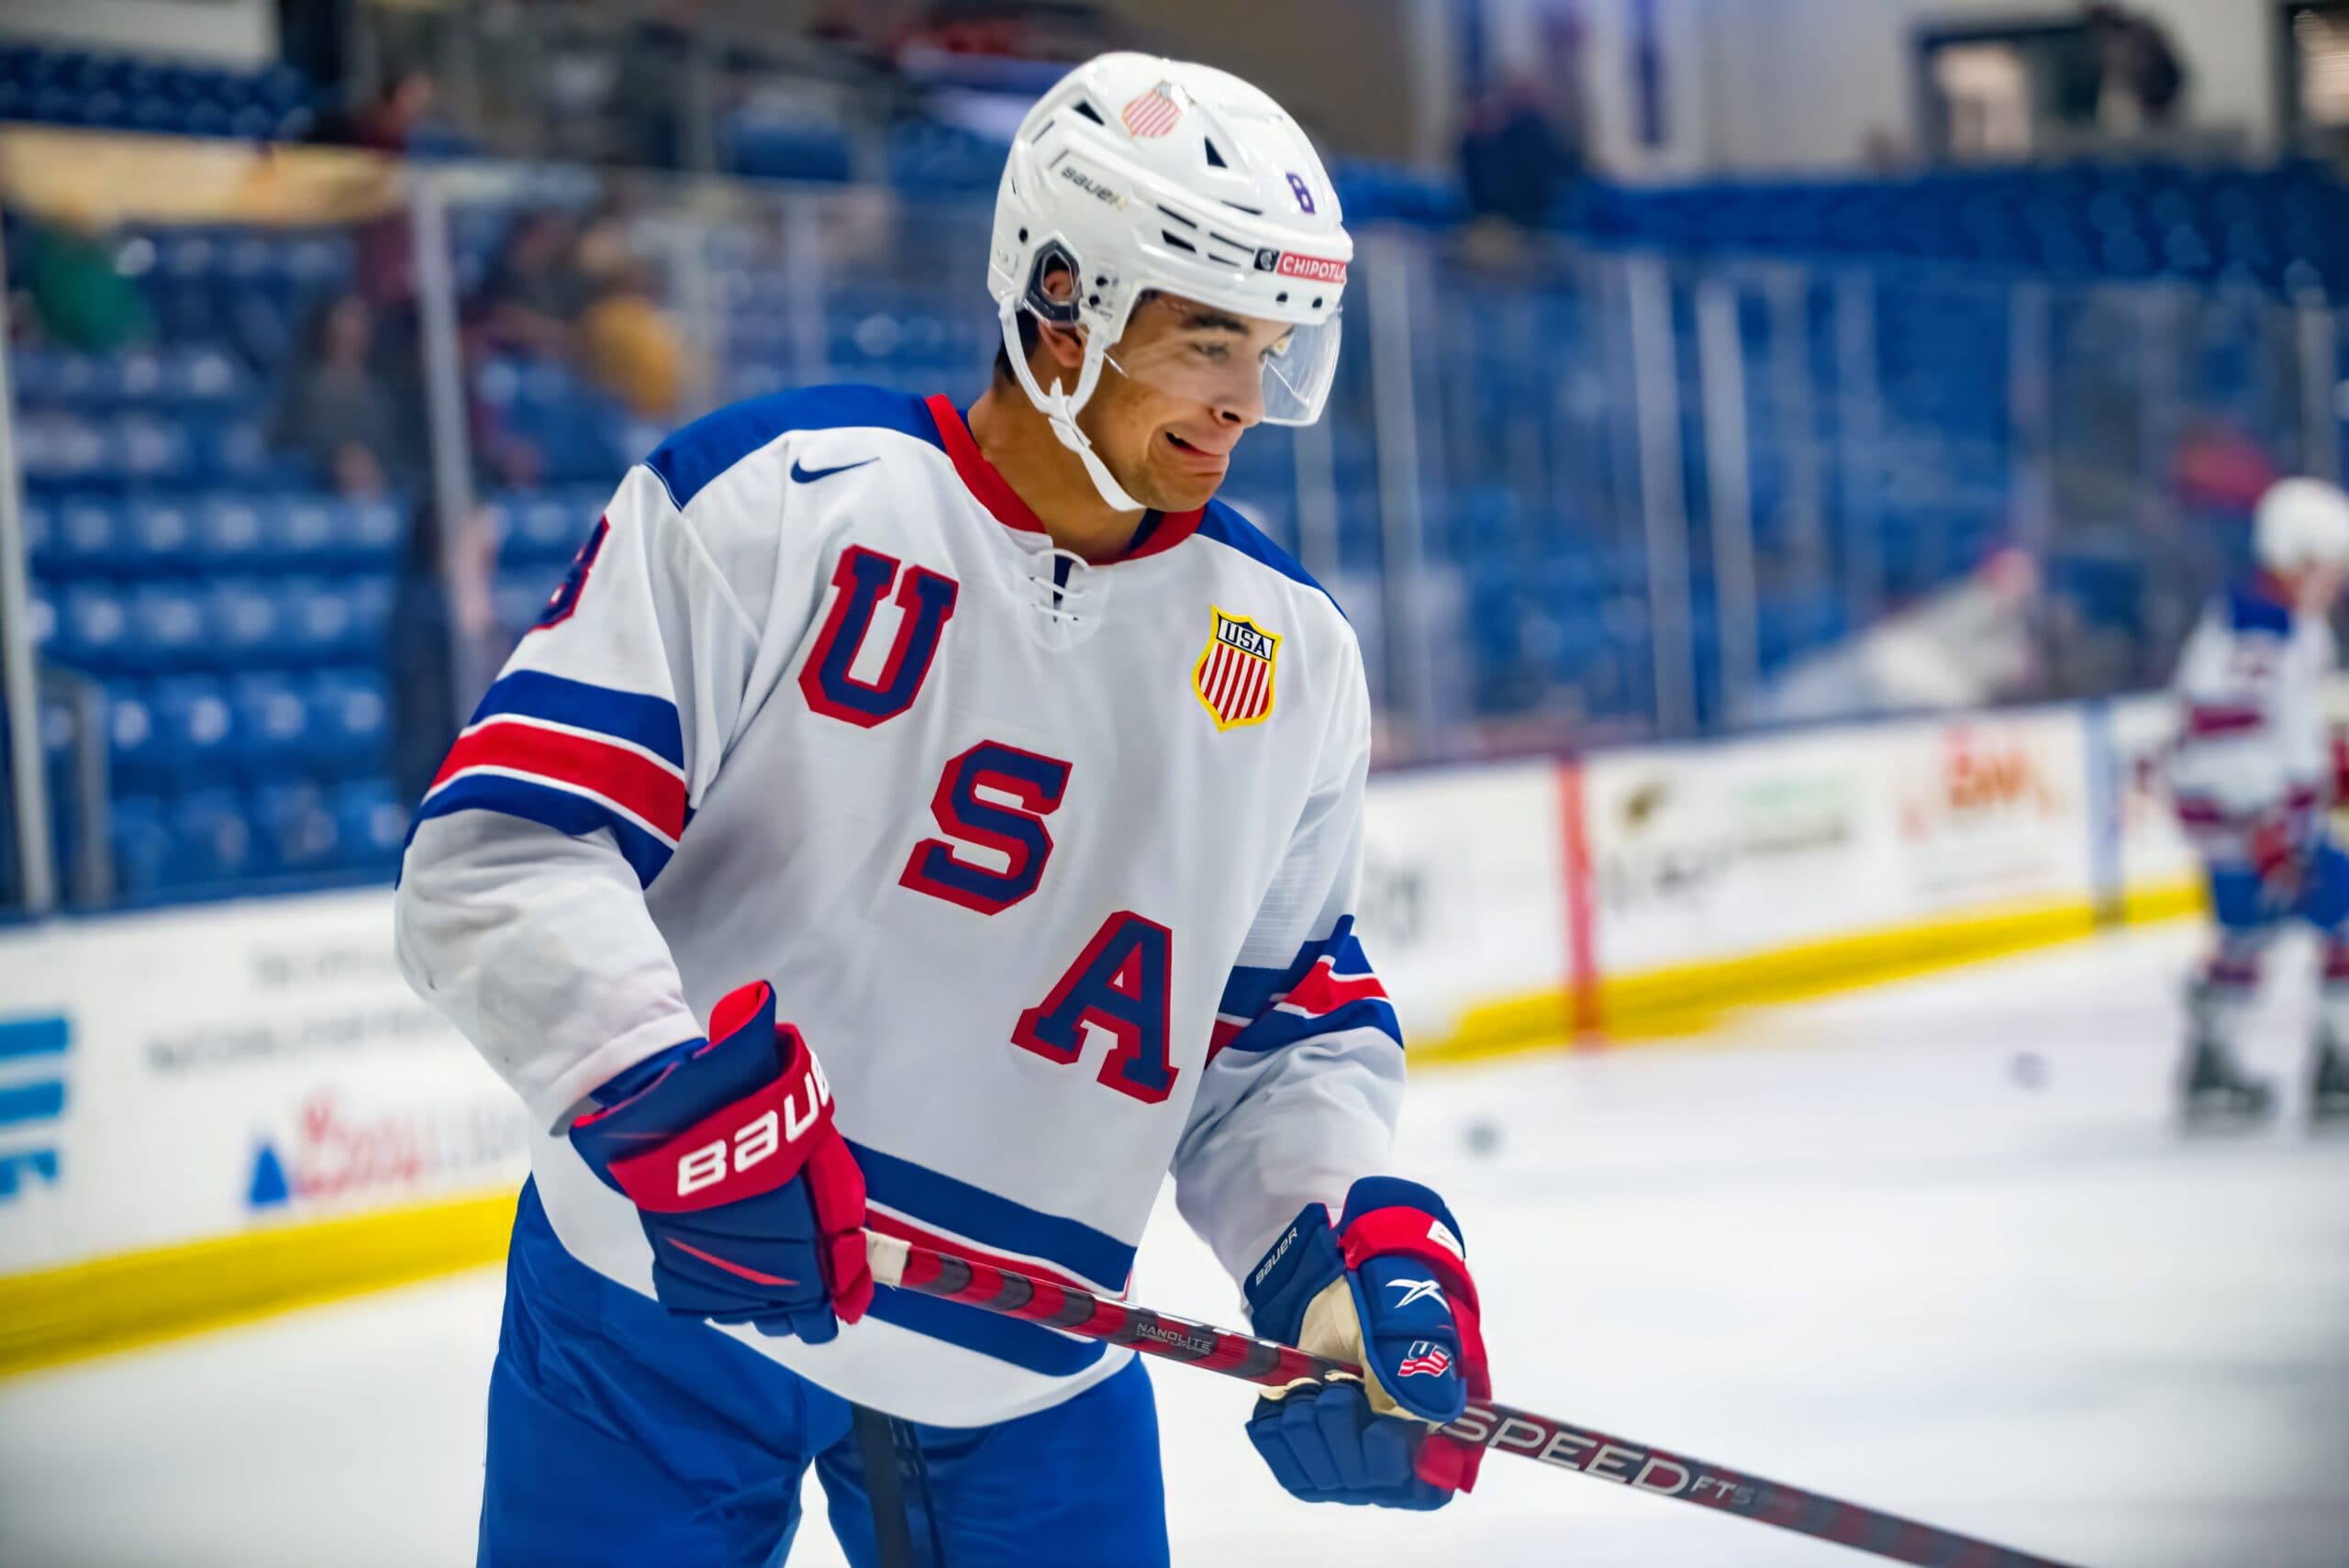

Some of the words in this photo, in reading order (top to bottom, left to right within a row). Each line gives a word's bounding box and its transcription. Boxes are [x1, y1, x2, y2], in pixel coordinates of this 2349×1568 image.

[1286, 172, 1316, 214] 8
[1225, 622, 1266, 657] USA
[1138, 1322, 1211, 1350] NANOLITE
